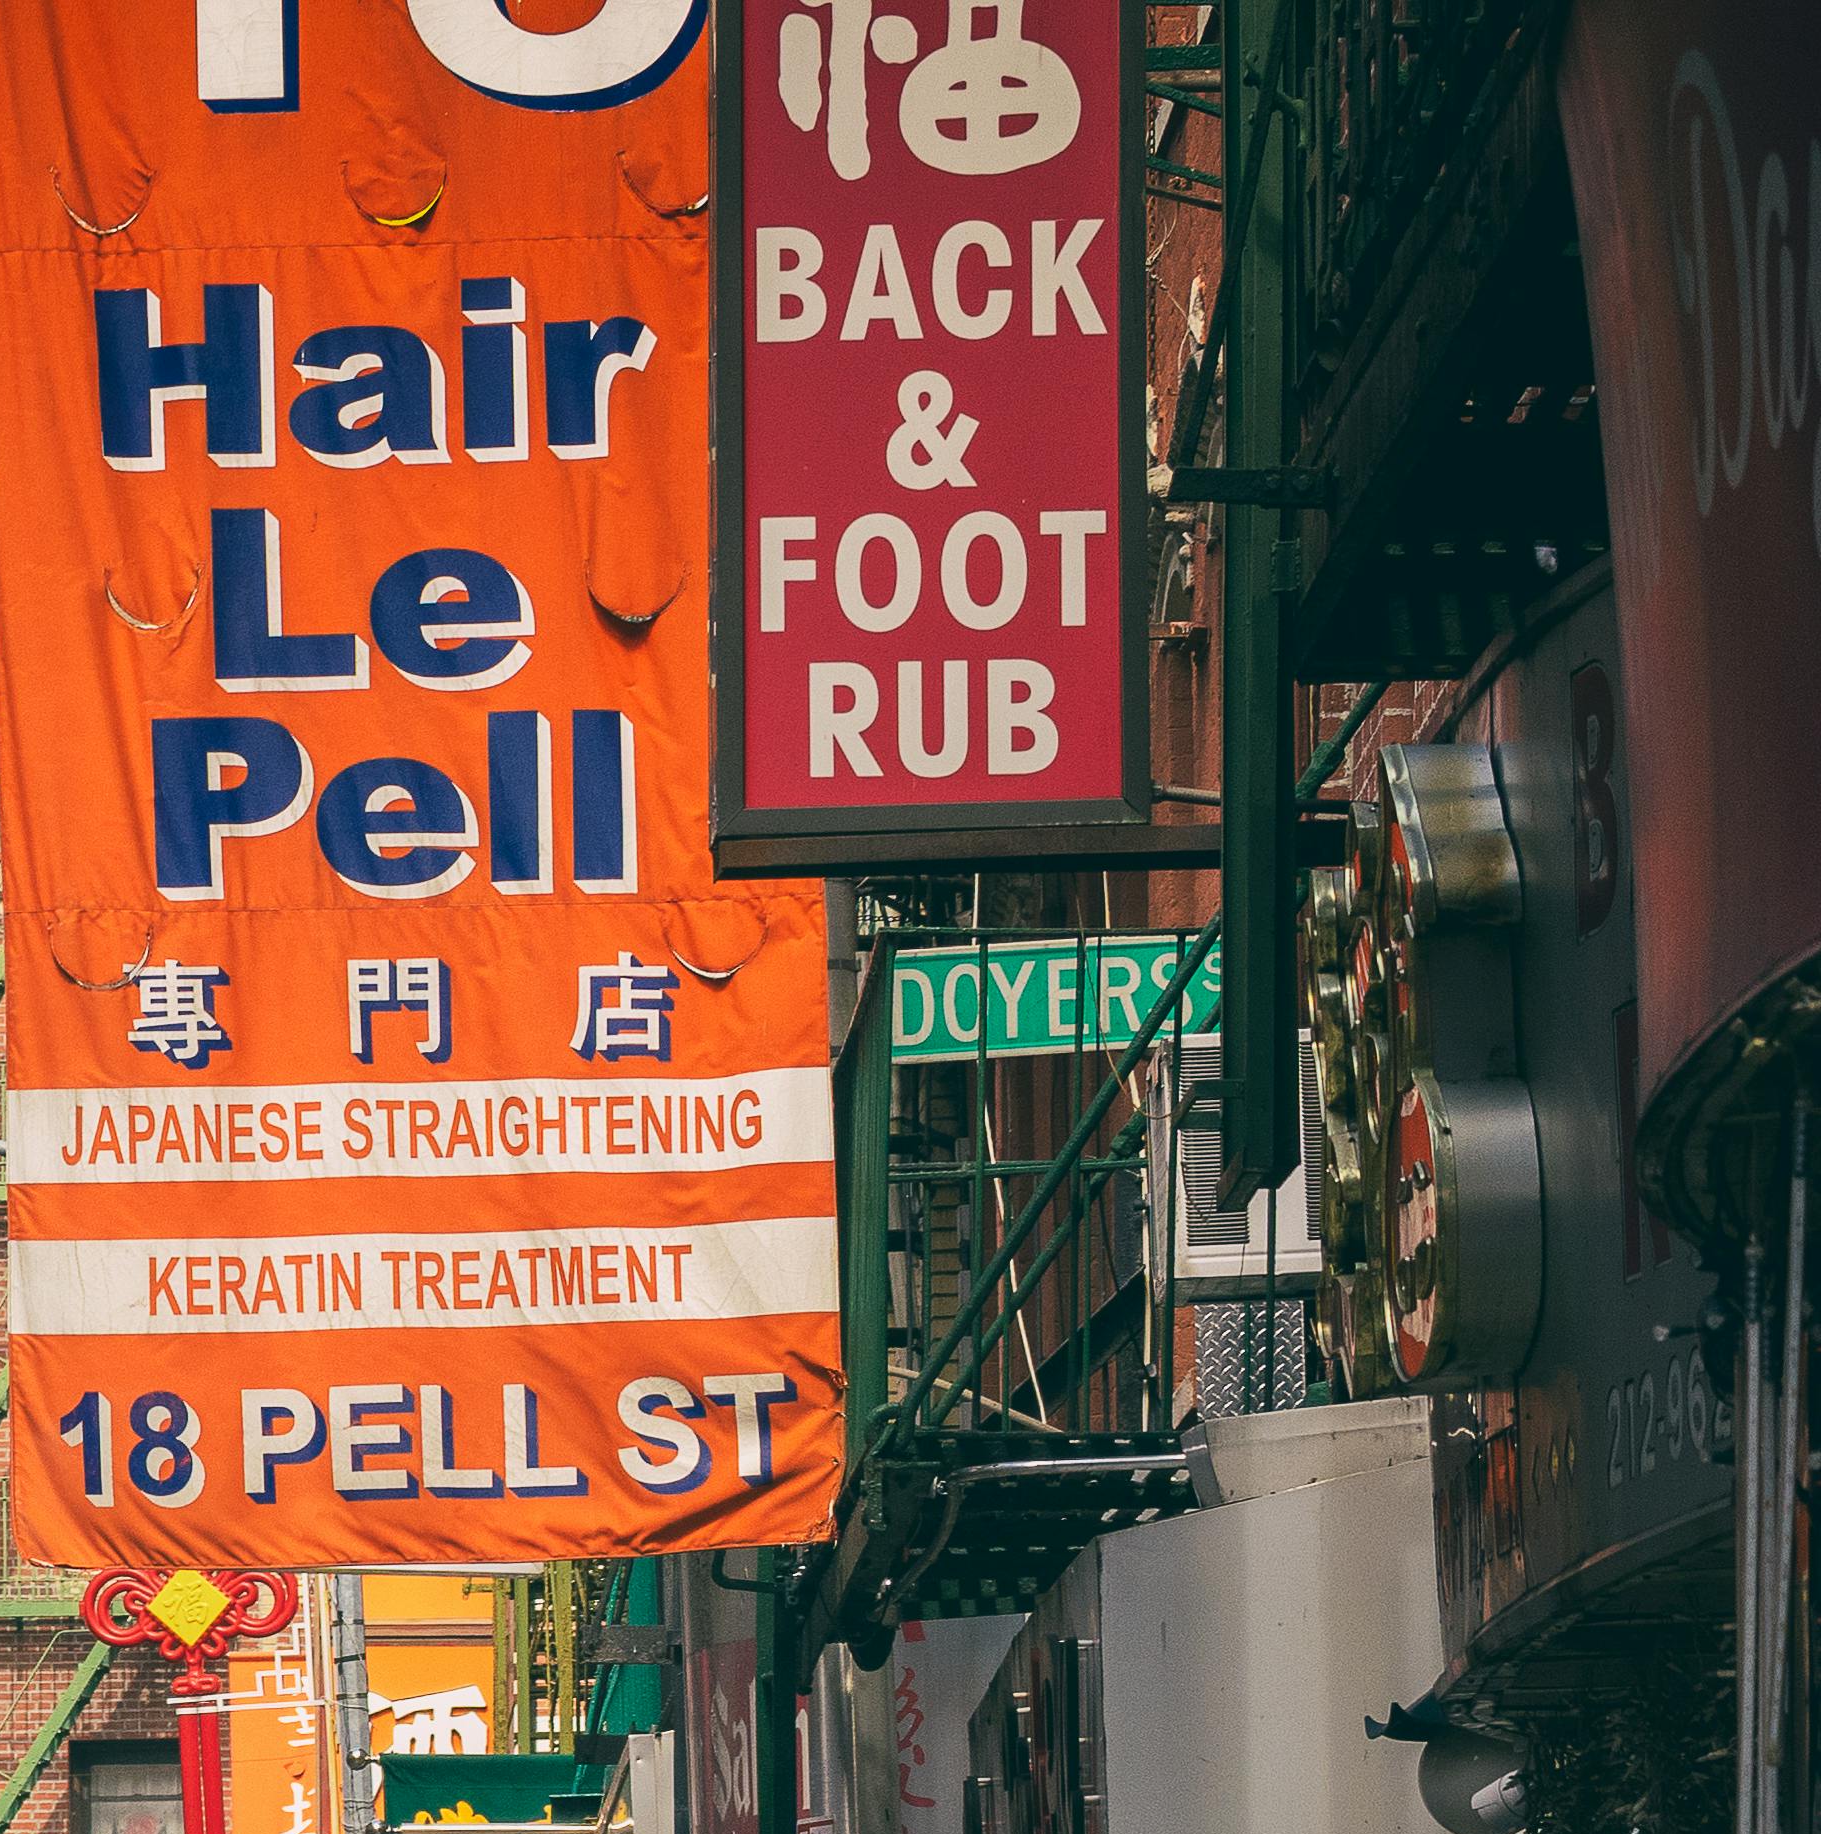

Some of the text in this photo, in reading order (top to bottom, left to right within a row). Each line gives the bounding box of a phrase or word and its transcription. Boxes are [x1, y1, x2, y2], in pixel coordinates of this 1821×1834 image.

[756, 218, 1108, 343] BACK
[94, 276, 658, 471] Hair
[885, 370, 980, 490] &
[210, 507, 536, 693] Le
[759, 509, 1107, 632] FOOT
[808, 658, 1059, 778] RUB
[150, 709, 638, 902] Pell
[121, 949, 680, 1071] 專門店
[60, 1087, 764, 1168] JAPANESE STRAIGHTENING
[148, 1243, 693, 1318] KERATIN TREATMENT
[59, 1372, 798, 1509] 18 PELL ST
